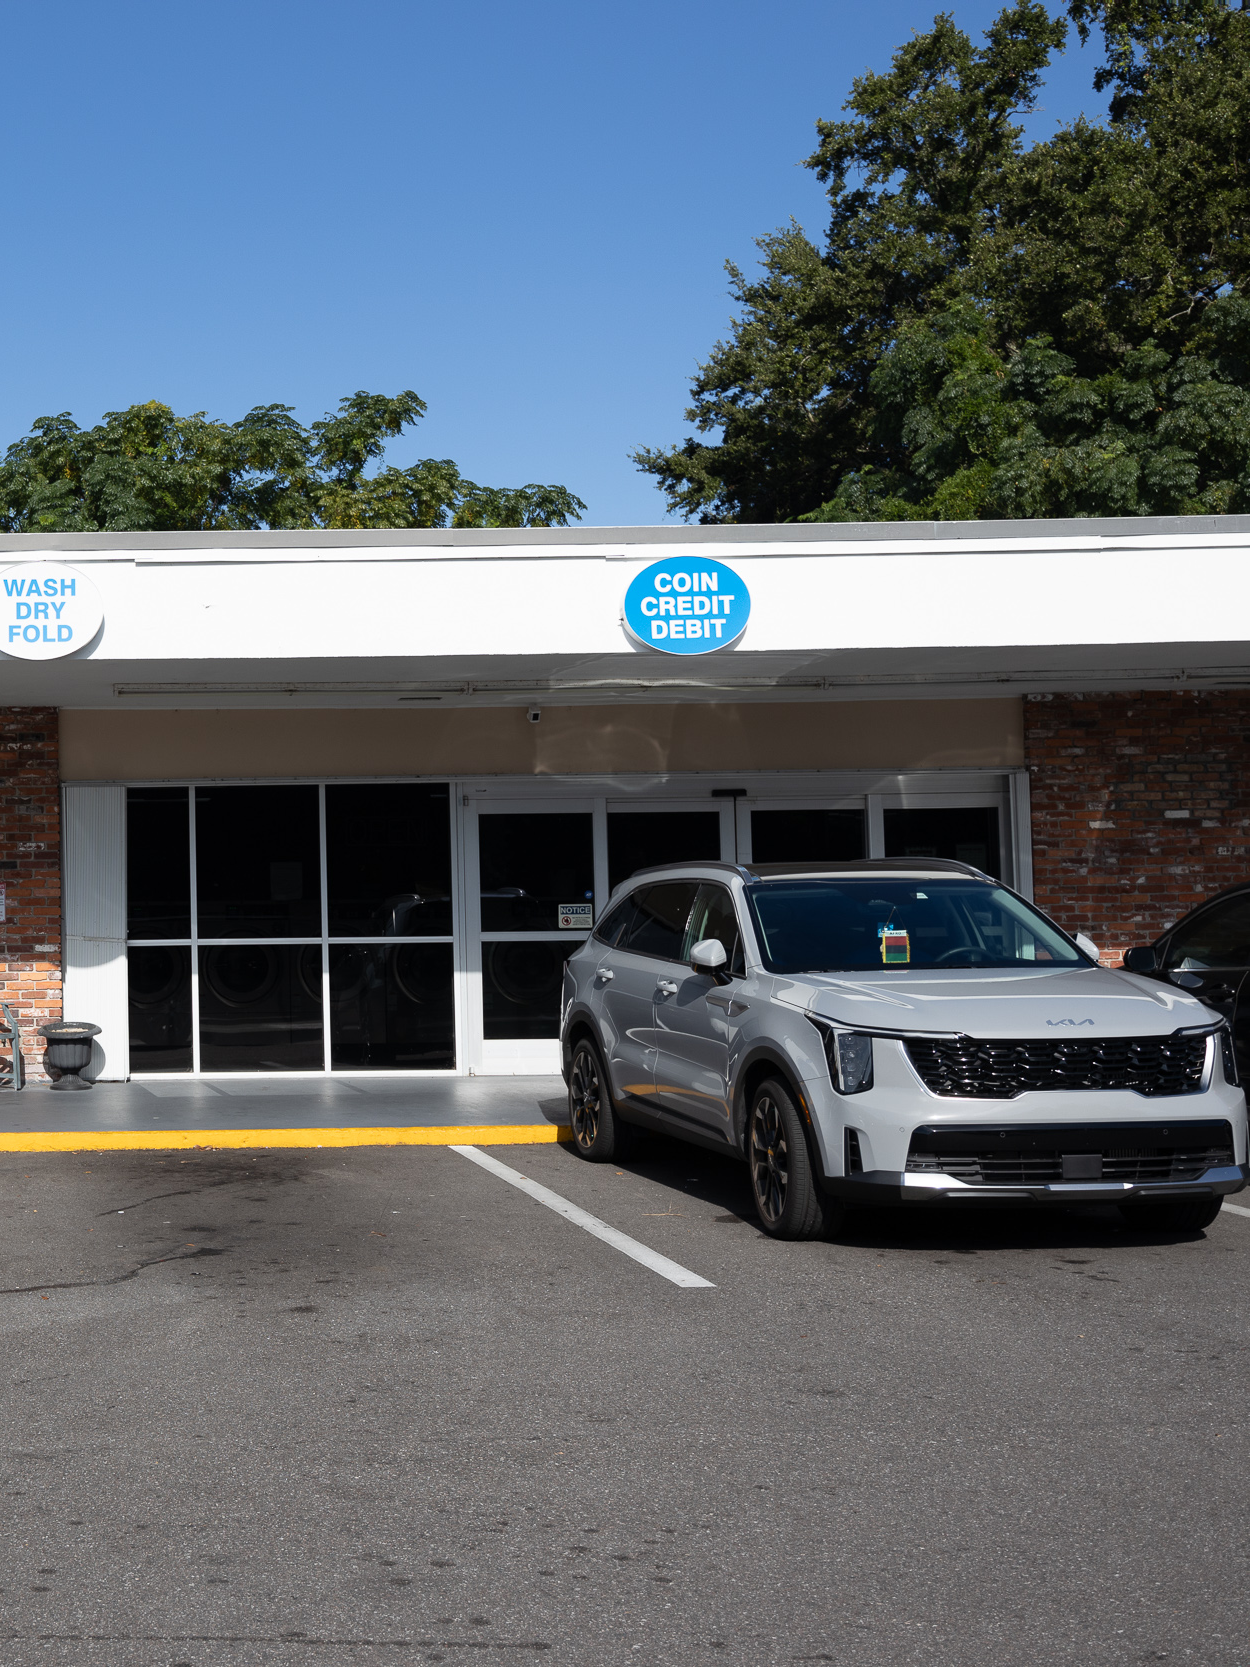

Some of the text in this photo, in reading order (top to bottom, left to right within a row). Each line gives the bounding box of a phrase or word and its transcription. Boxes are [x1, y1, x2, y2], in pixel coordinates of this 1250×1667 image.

[3, 578, 76, 597] WASH
[654, 572, 718, 593] COIN
[16, 601, 66, 620] DRY
[640, 595, 735, 617] CREDIT
[8, 625, 73, 643] FOLD
[650, 619, 727, 640] DEBIT
[560, 906, 590, 914] NOTICE
[1046, 1018, 1095, 1026] KIA
